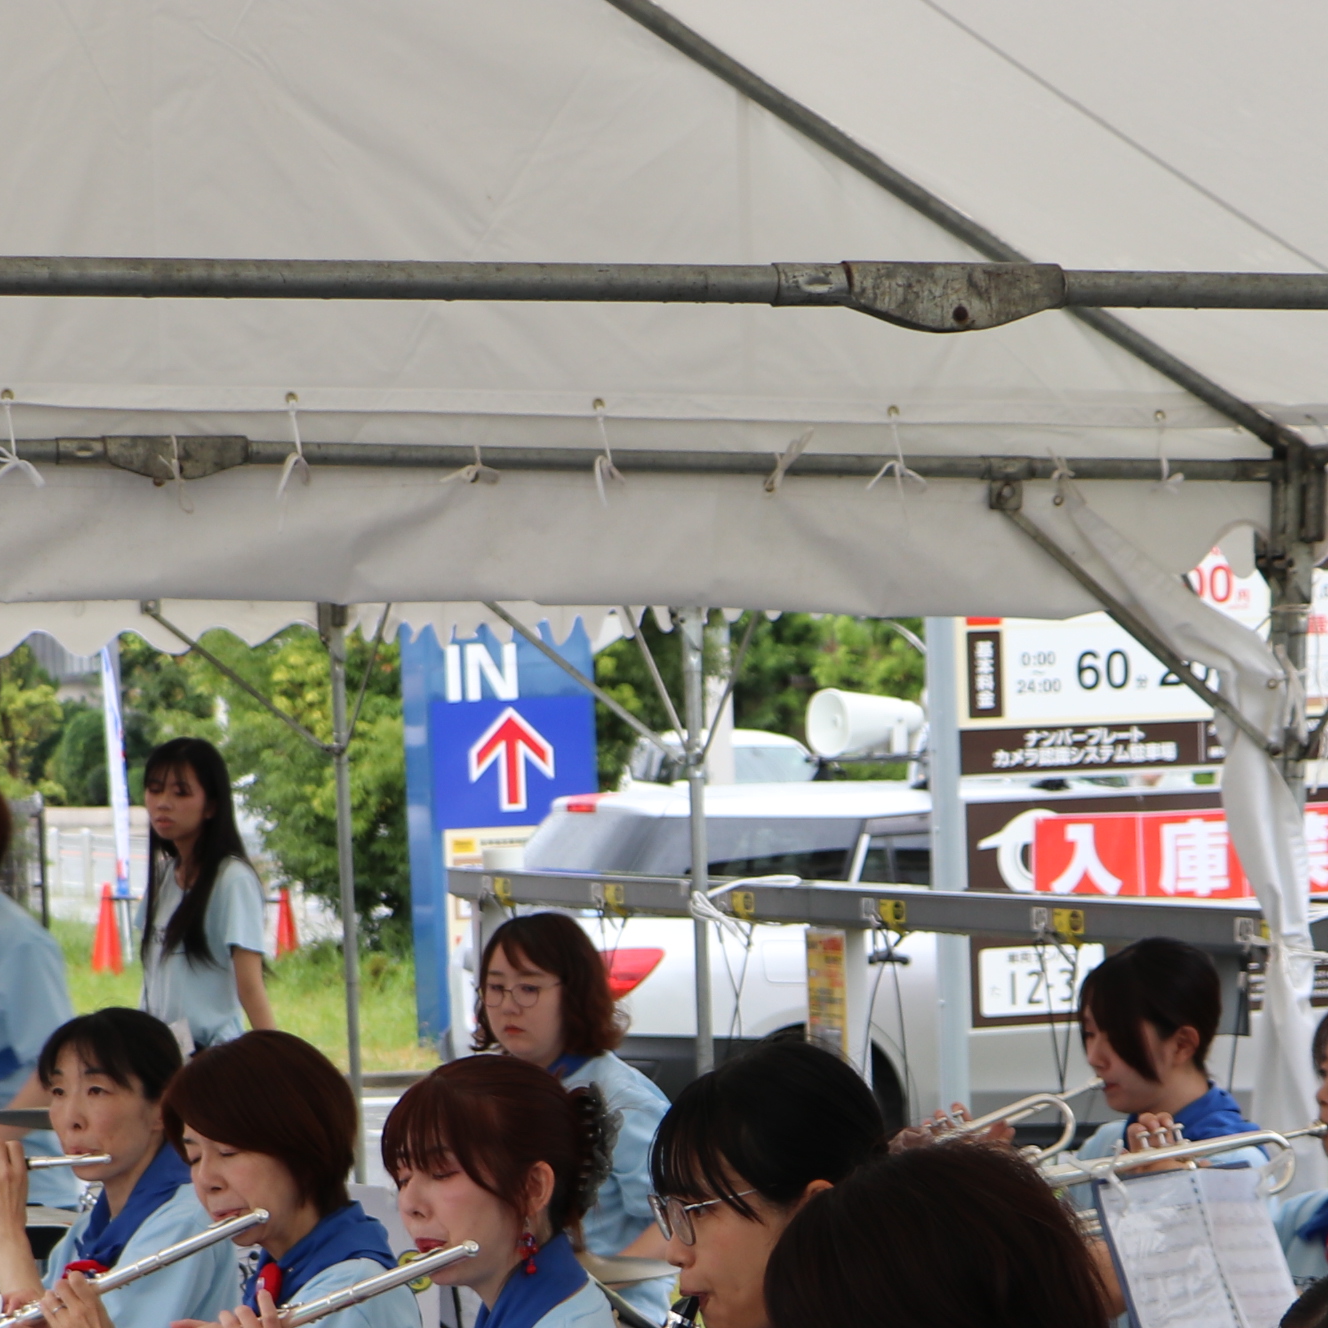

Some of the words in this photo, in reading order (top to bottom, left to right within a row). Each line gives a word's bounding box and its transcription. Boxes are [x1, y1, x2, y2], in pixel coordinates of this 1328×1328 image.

[1021, 651, 1055, 666] 0:00
[446, 643, 518, 701] IN
[1017, 679, 1061, 693] 24:00
[1024, 726, 1146, 747] ナンバープレート
[1010, 966, 1093, 1005] 12-3
